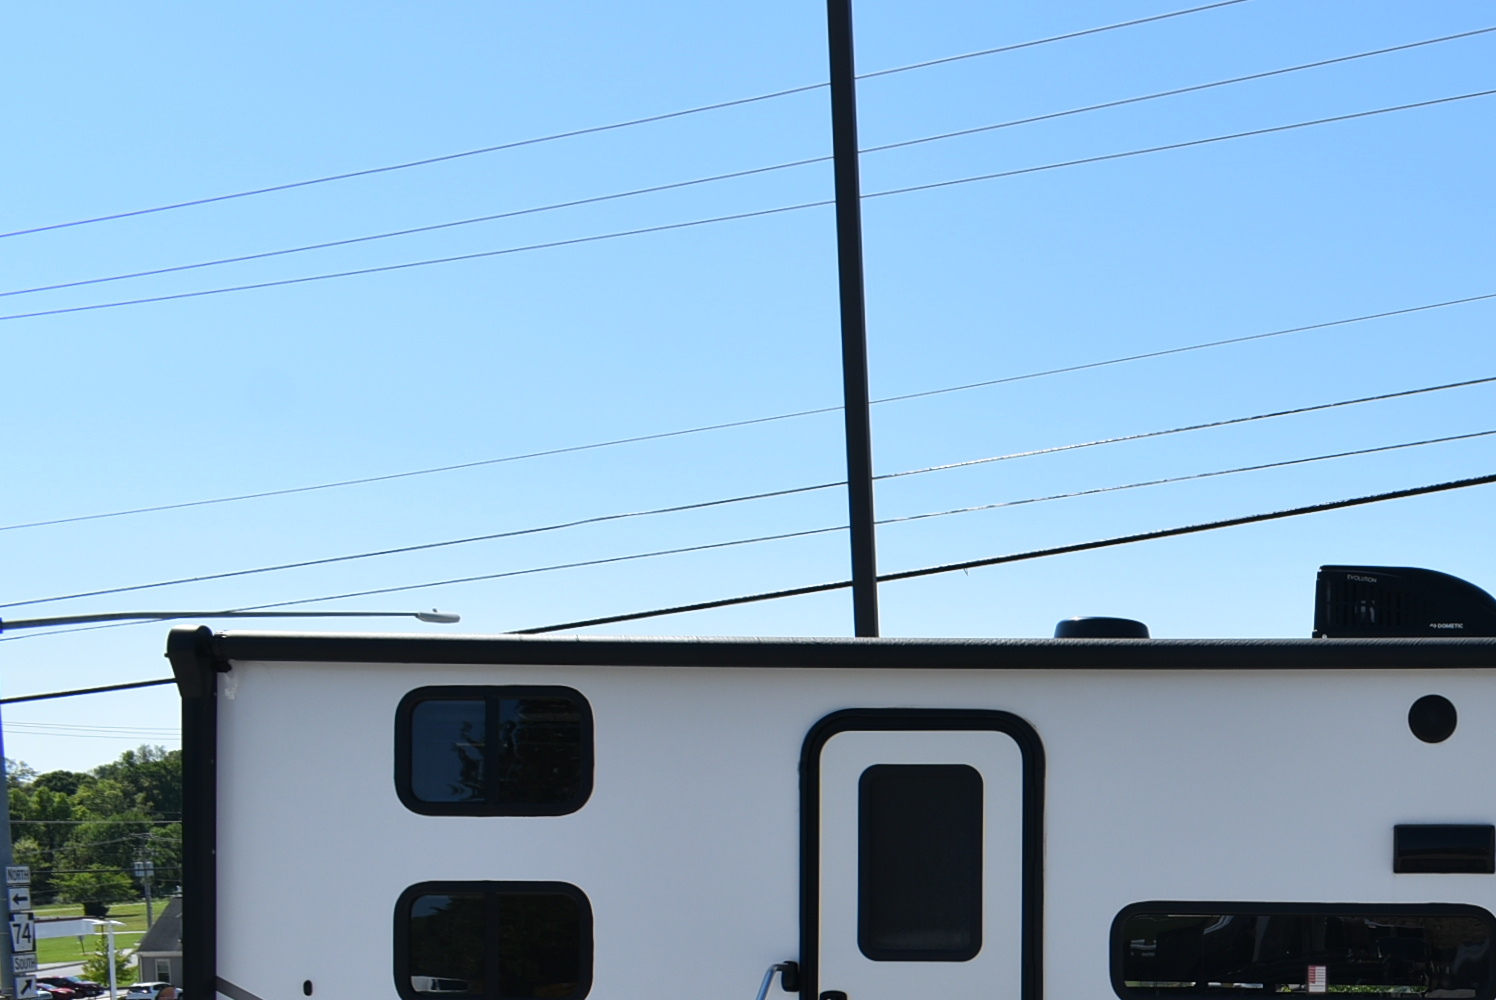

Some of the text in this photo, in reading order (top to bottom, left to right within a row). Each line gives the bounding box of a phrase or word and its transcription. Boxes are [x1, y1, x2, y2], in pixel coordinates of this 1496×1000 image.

[1347, 574, 1377, 583] EVOLUTION
[8, 869, 29, 881] NORTH
[12, 923, 31, 944] 74
[15, 957, 36, 970] SOUTH
